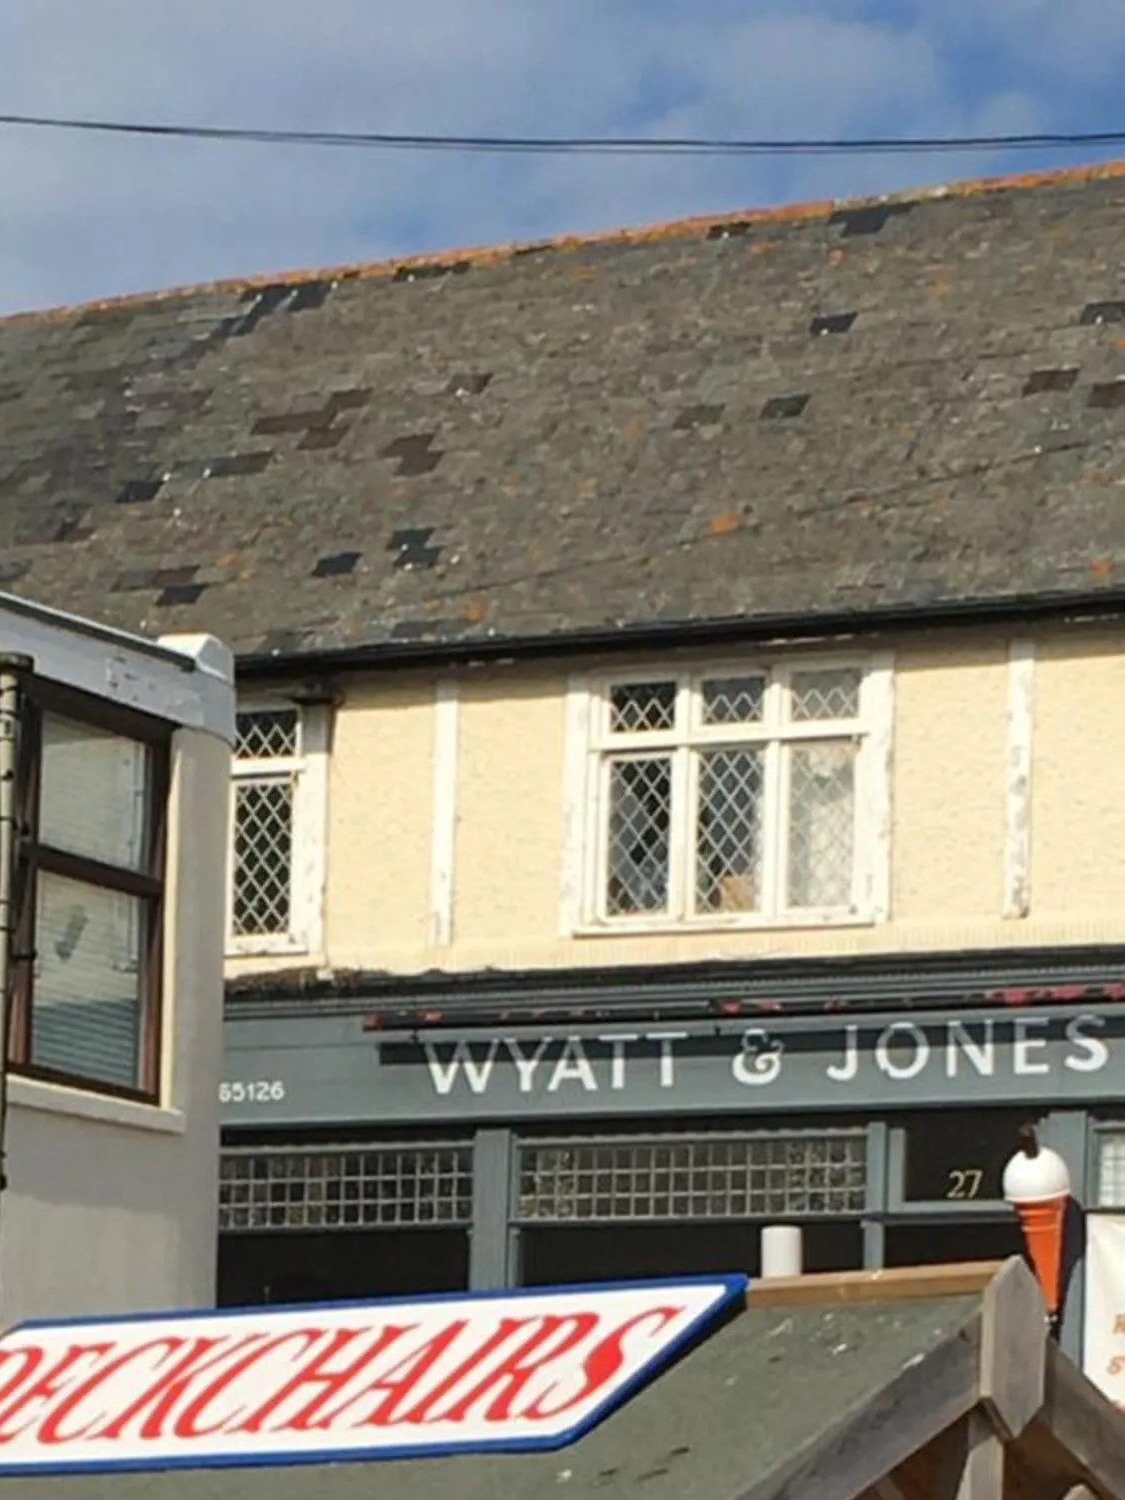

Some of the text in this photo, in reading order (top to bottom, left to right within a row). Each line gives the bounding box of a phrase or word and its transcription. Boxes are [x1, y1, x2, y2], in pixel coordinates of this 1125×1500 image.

[424, 1015, 1109, 1094] WYATT & JONES
[946, 1168, 983, 1199] 27
